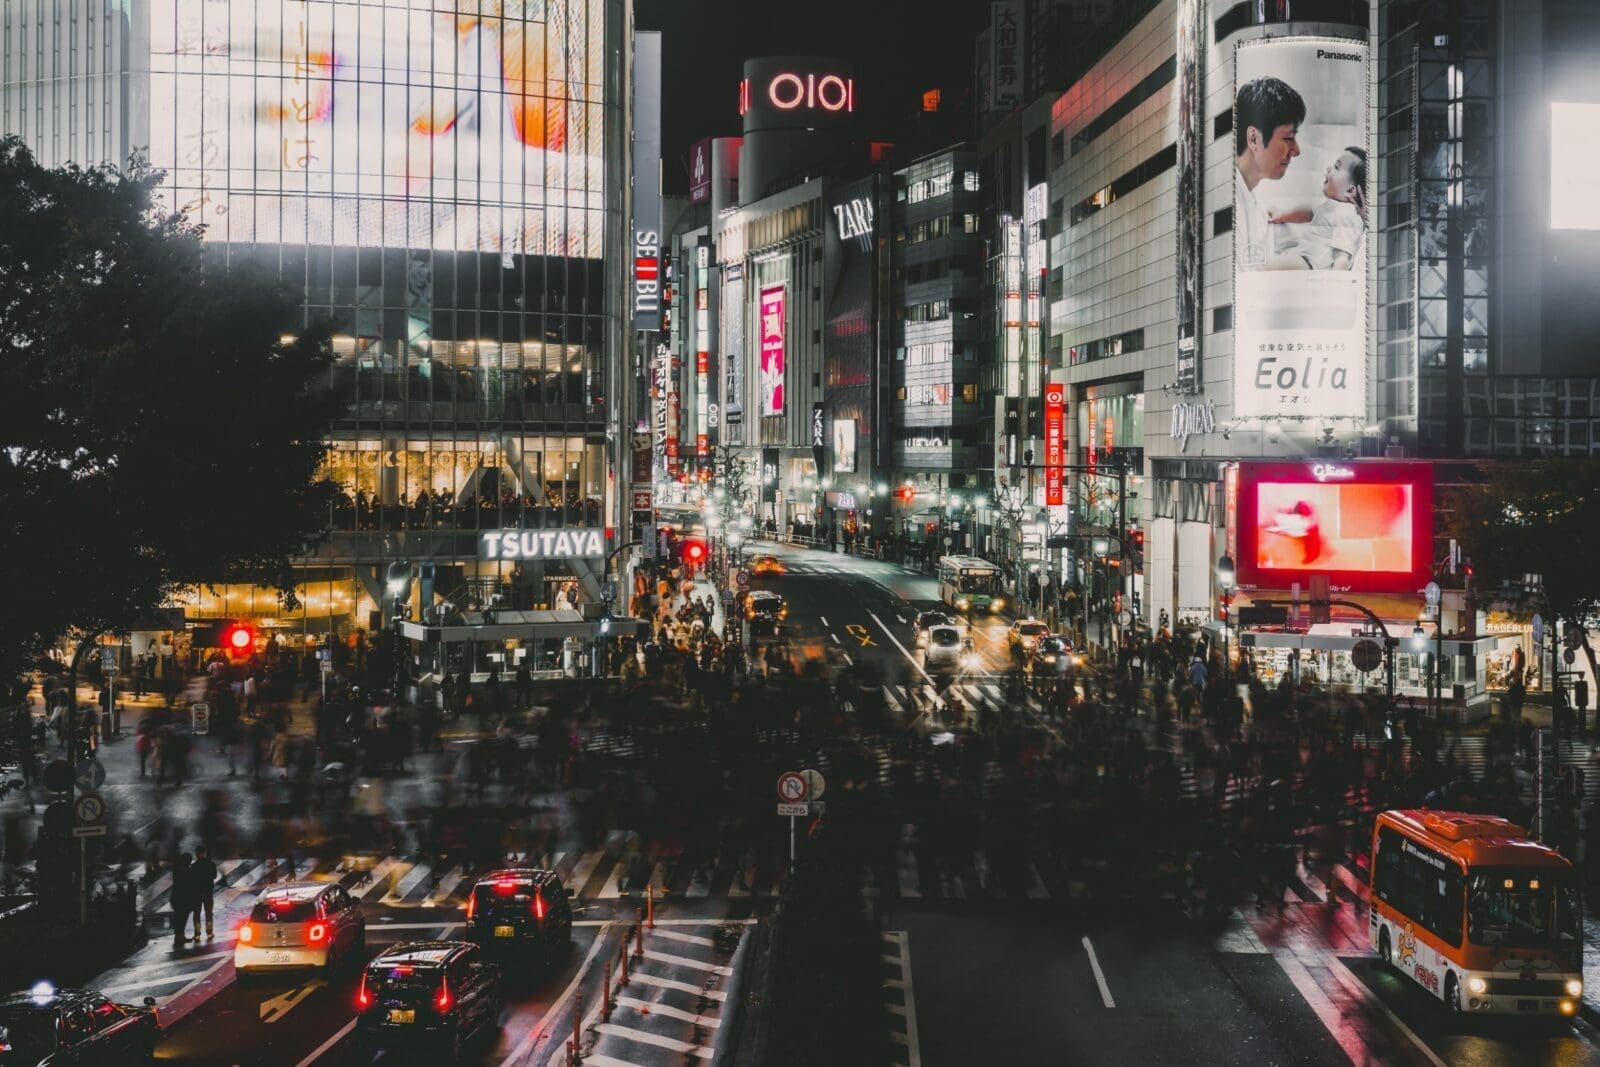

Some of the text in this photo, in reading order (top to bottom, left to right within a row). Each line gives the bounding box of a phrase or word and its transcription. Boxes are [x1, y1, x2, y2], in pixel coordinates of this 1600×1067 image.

[1317, 50, 1362, 62] Panasonic
[636, 231, 658, 311] SEIBU
[1254, 357, 1348, 389] Eolia
[813, 409, 824, 446] ZARA
[636, 494, 649, 507] 本
[484, 531, 603, 558] TSUTAYA
